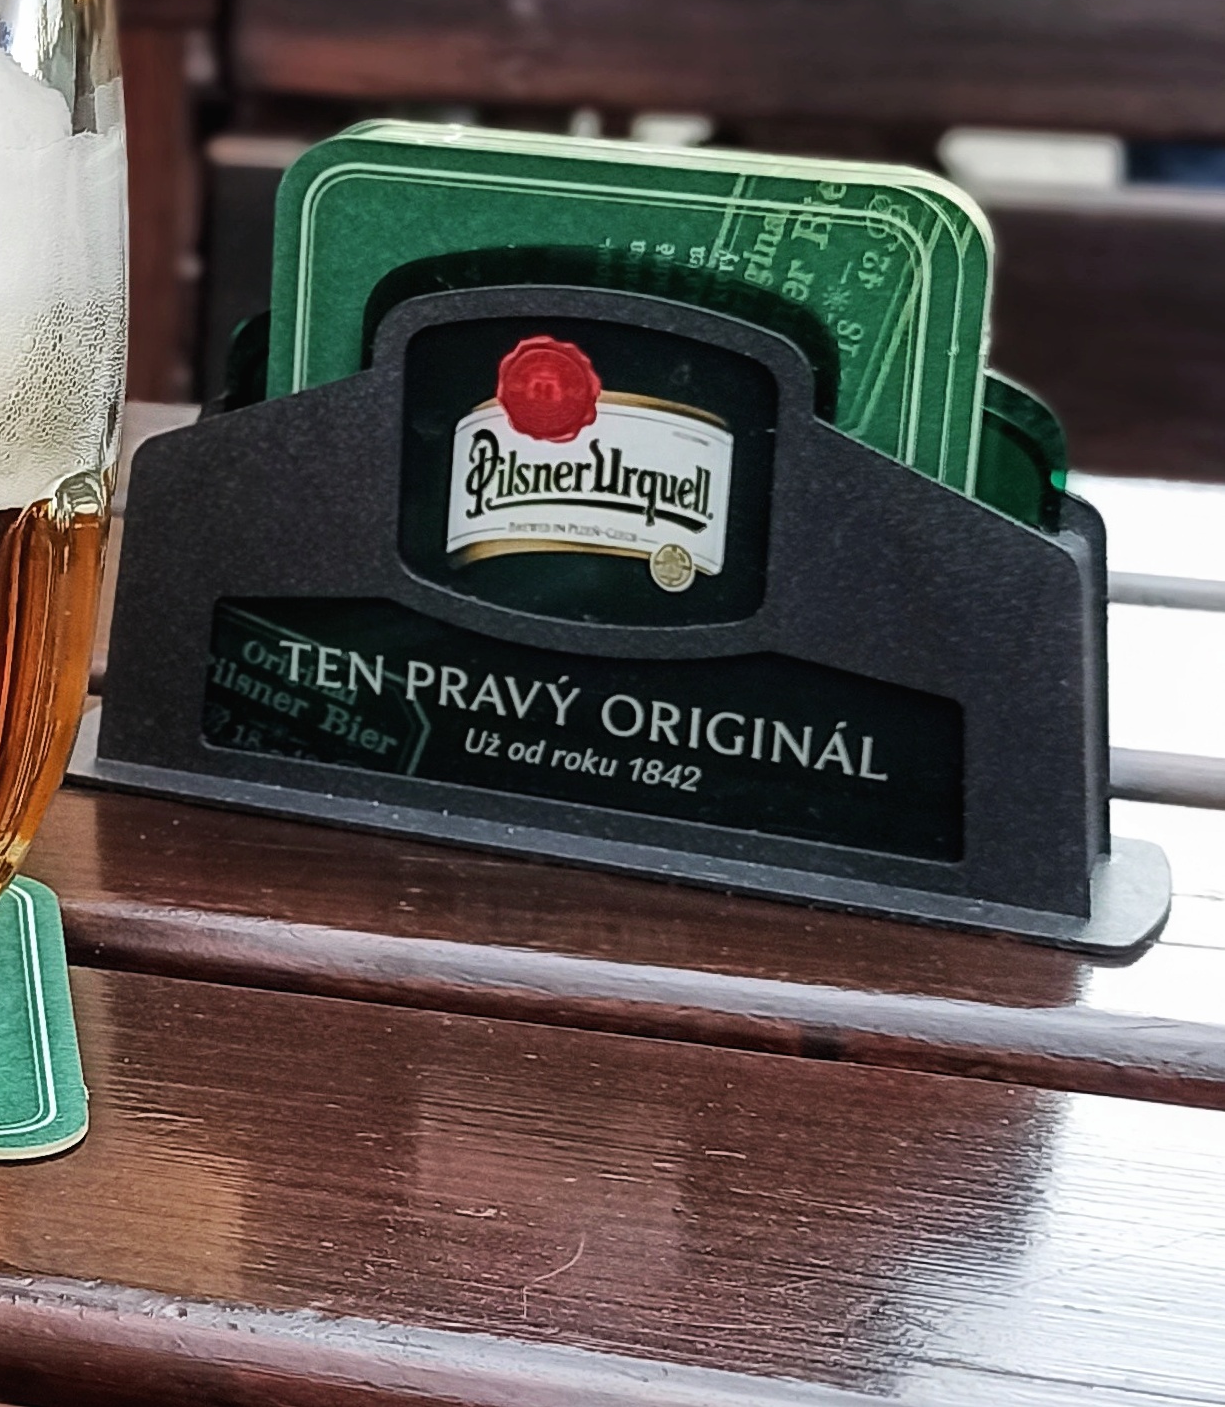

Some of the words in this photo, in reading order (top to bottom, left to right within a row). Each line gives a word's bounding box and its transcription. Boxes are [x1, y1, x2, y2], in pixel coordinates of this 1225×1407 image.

[465, 428, 593, 520] Pilsner
[589, 438, 714, 528] Urquell
[207, 656, 310, 719] ilsner
[318, 703, 399, 755] Bier
[279, 639, 384, 696] TEN
[405, 661, 581, 727] PRAVÝ
[601, 694, 888, 782] ORIGINÁL
[464, 727, 501, 759] Už
[507, 736, 544, 766] od
[552, 745, 619, 777] roku
[628, 757, 702, 793] 1842
